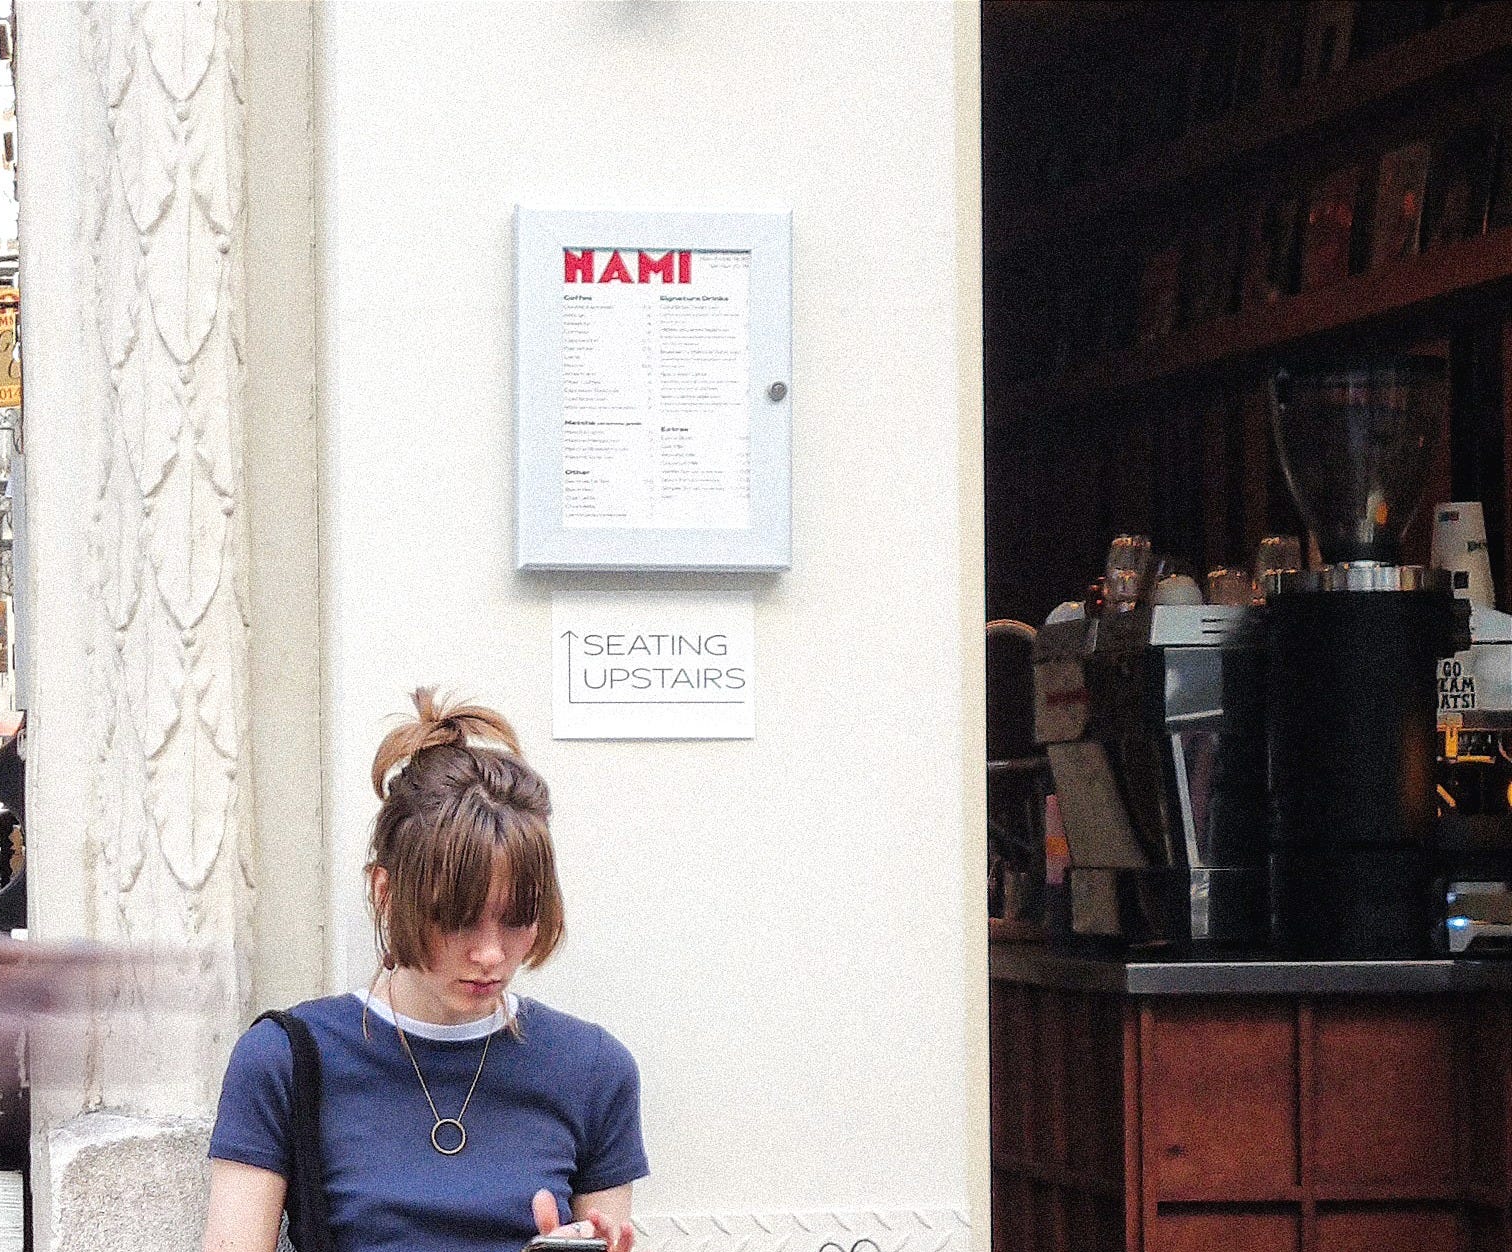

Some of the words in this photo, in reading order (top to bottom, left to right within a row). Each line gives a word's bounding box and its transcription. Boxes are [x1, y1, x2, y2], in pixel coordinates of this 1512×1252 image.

[564, 249, 692, 284] NAMI
[583, 634, 728, 656] SEATING
[583, 667, 747, 689] UPSTAIRS
[1440, 693, 1476, 709] ATS!
